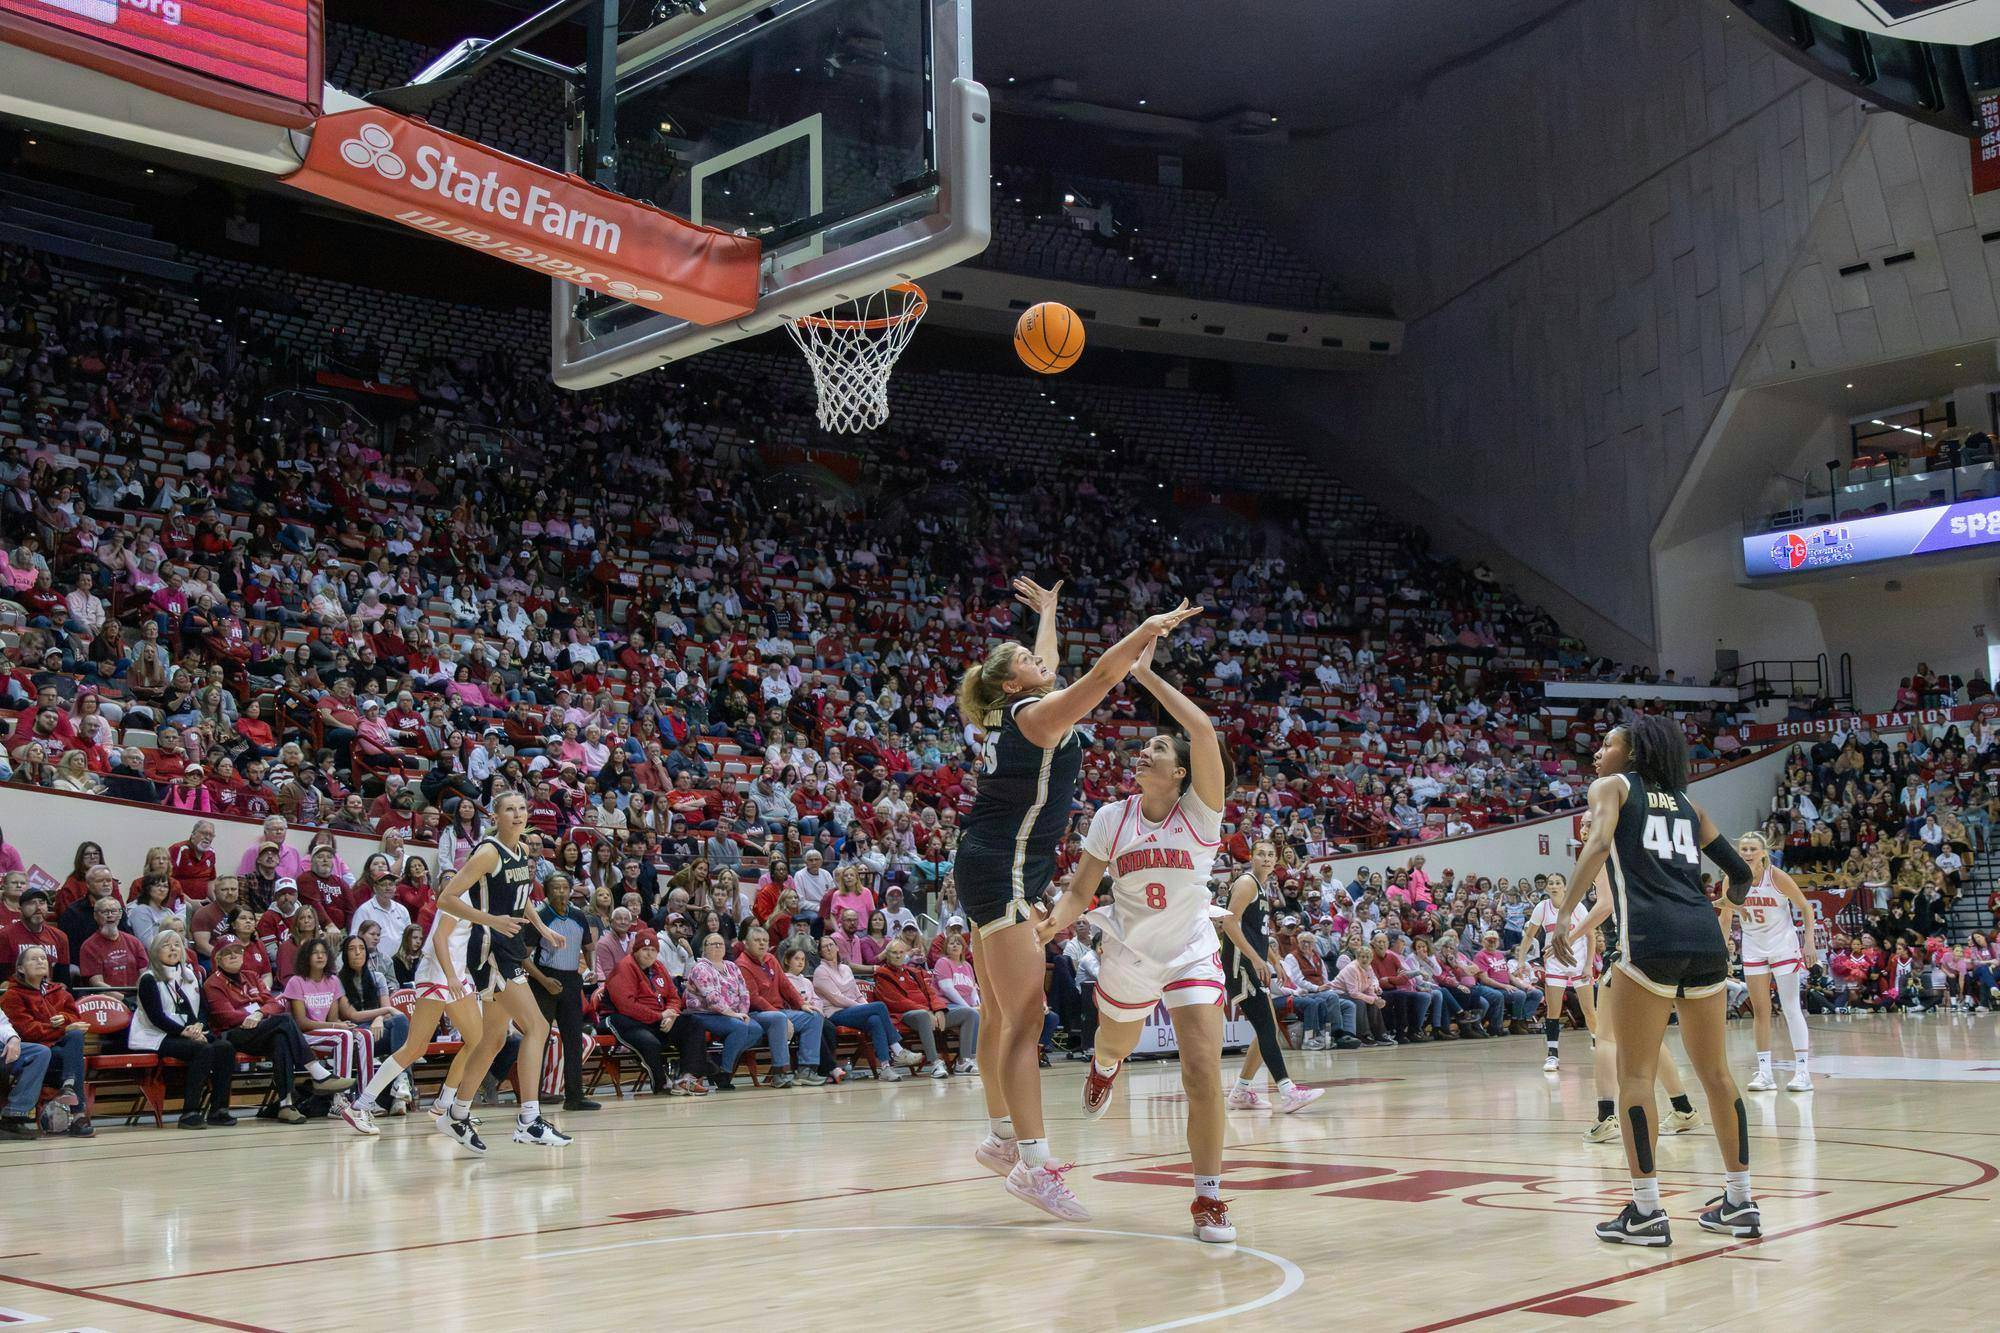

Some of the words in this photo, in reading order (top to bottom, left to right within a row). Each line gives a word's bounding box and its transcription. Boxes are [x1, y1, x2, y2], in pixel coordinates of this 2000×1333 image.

[1642, 814, 1700, 865] 44
[1116, 848, 1195, 878] INDIANA
[1145, 883, 1167, 910] 8
[78, 1000, 125, 1013] INDIANA
[392, 993, 416, 1008] INDIA
